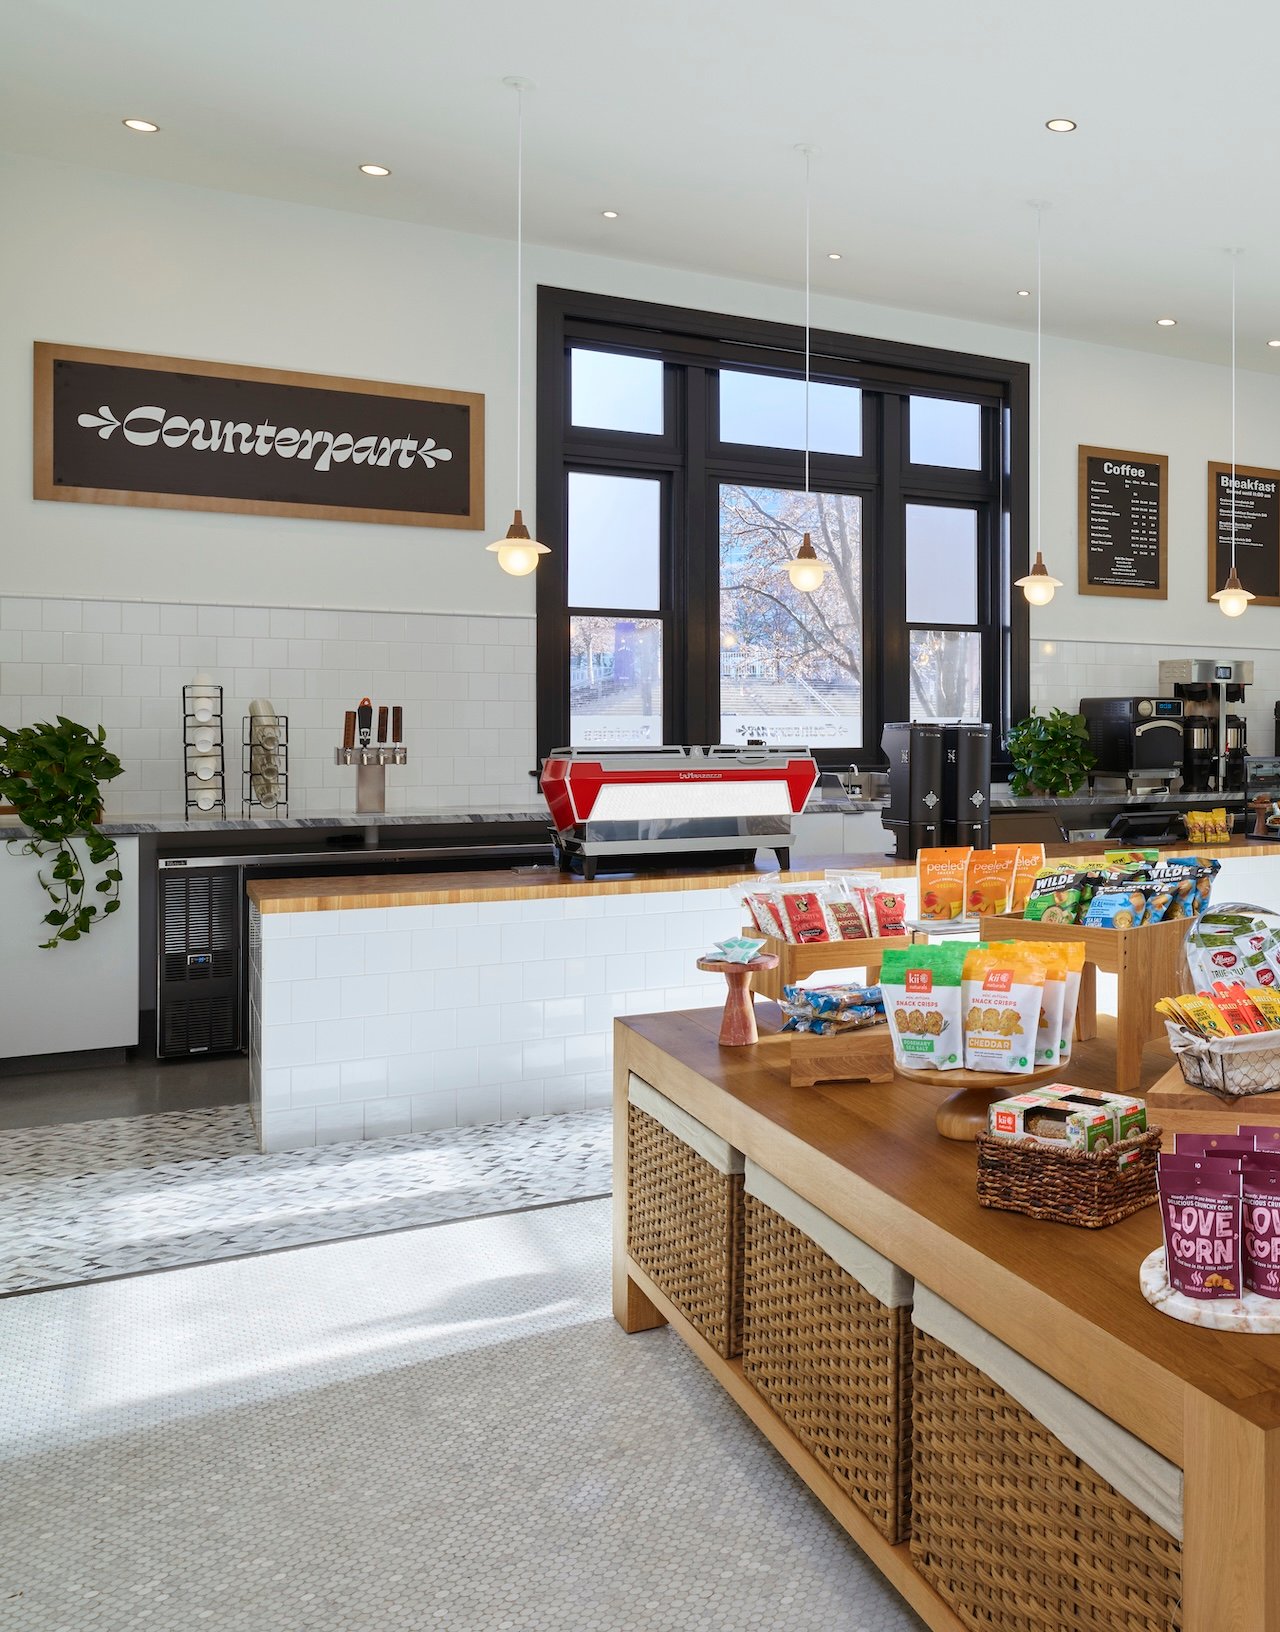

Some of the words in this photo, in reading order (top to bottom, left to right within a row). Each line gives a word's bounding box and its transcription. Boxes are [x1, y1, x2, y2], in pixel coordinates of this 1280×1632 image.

[123, 405, 418, 471] Counterpart
[1103, 462, 1145, 477] Coffee
[1220, 475, 1276, 492] Breakfast
[927, 860, 965, 875] peeled
[973, 861, 1009, 874] peeled
[1016, 856, 1037, 867] eled
[1149, 867, 1191, 880] WILDE
[1036, 873, 1076, 889] WILDE
[908, 973, 919, 984] kii
[988, 973, 1001, 982] kii
[1211, 970, 1227, 979] TRUE
[993, 999, 1017, 1007] CRISPS
[969, 1038, 1010, 1049] CHEDDAR
[1194, 1200, 1217, 1210] CRUNCHY
[1217, 1202, 1233, 1211] CORN
